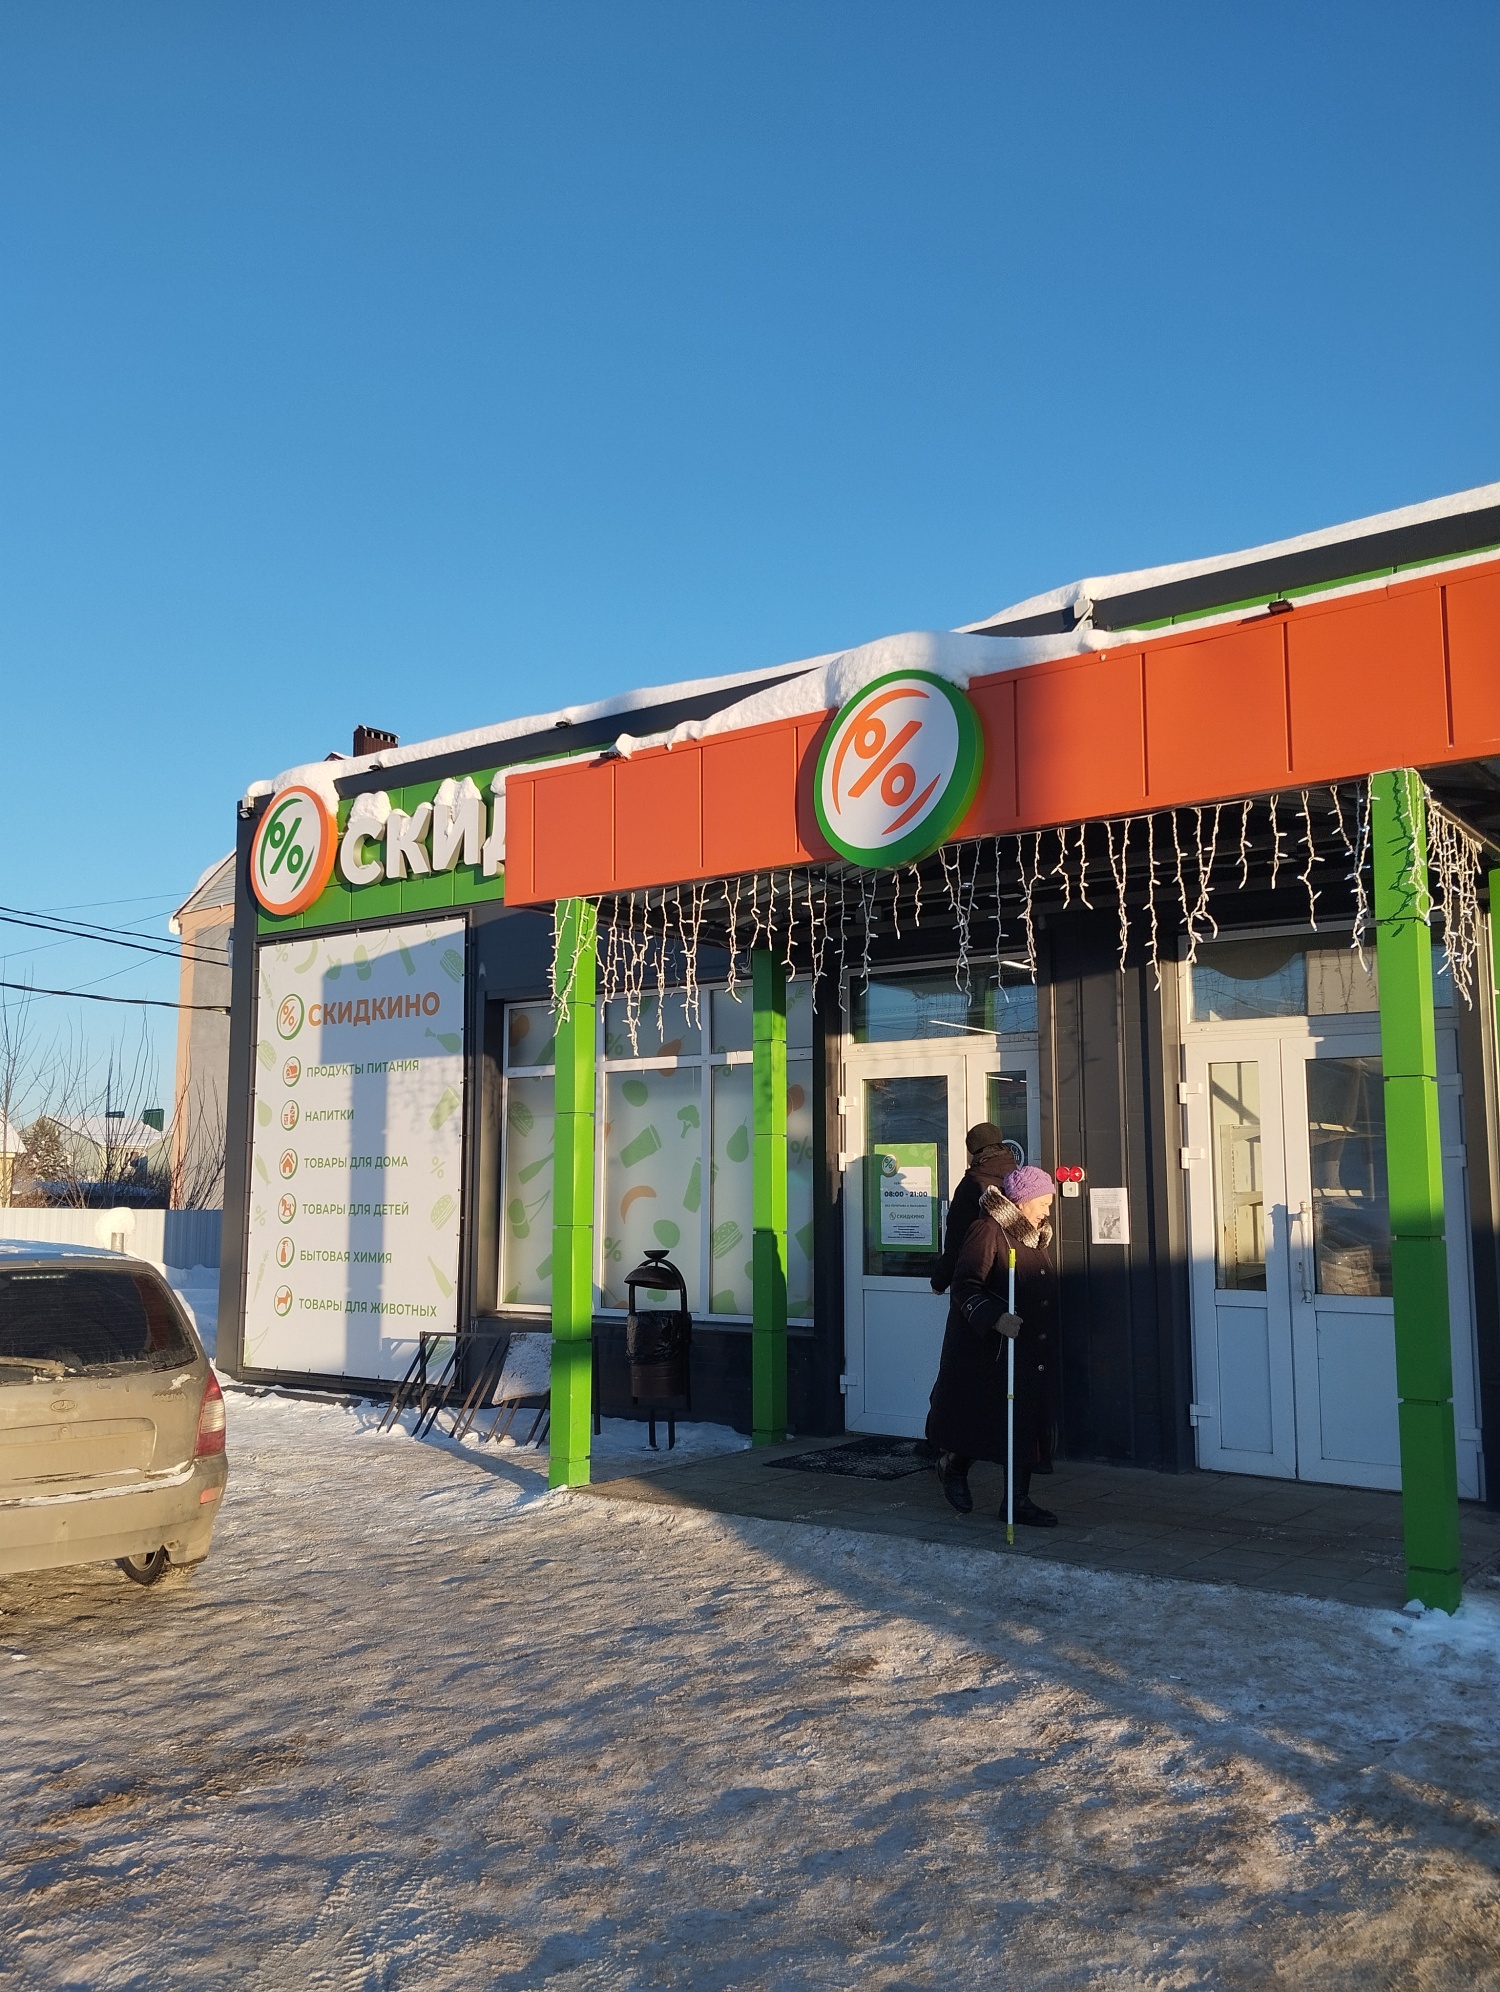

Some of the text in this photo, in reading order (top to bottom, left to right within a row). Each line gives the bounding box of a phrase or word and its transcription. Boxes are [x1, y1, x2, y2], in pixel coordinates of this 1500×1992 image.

[308, 991, 440, 1027] СКИДКИНО
[306, 1059, 419, 1078] ПРОДУКТЫ ПИТАНИЯ
[305, 1109, 354, 1122] НАПИТКИ
[304, 1155, 408, 1169] ТОВАРЫ ДЛЯ ДОМА
[302, 1202, 409, 1217] ТОВАРЫ ДЛЯ ДЕТЕЙ
[300, 1250, 392, 1264] БЫТОВАЯ ХИМИЯ
[299, 1298, 437, 1317] ТОВАРЫ ДЛЯ ЖИВОТНЫХ
